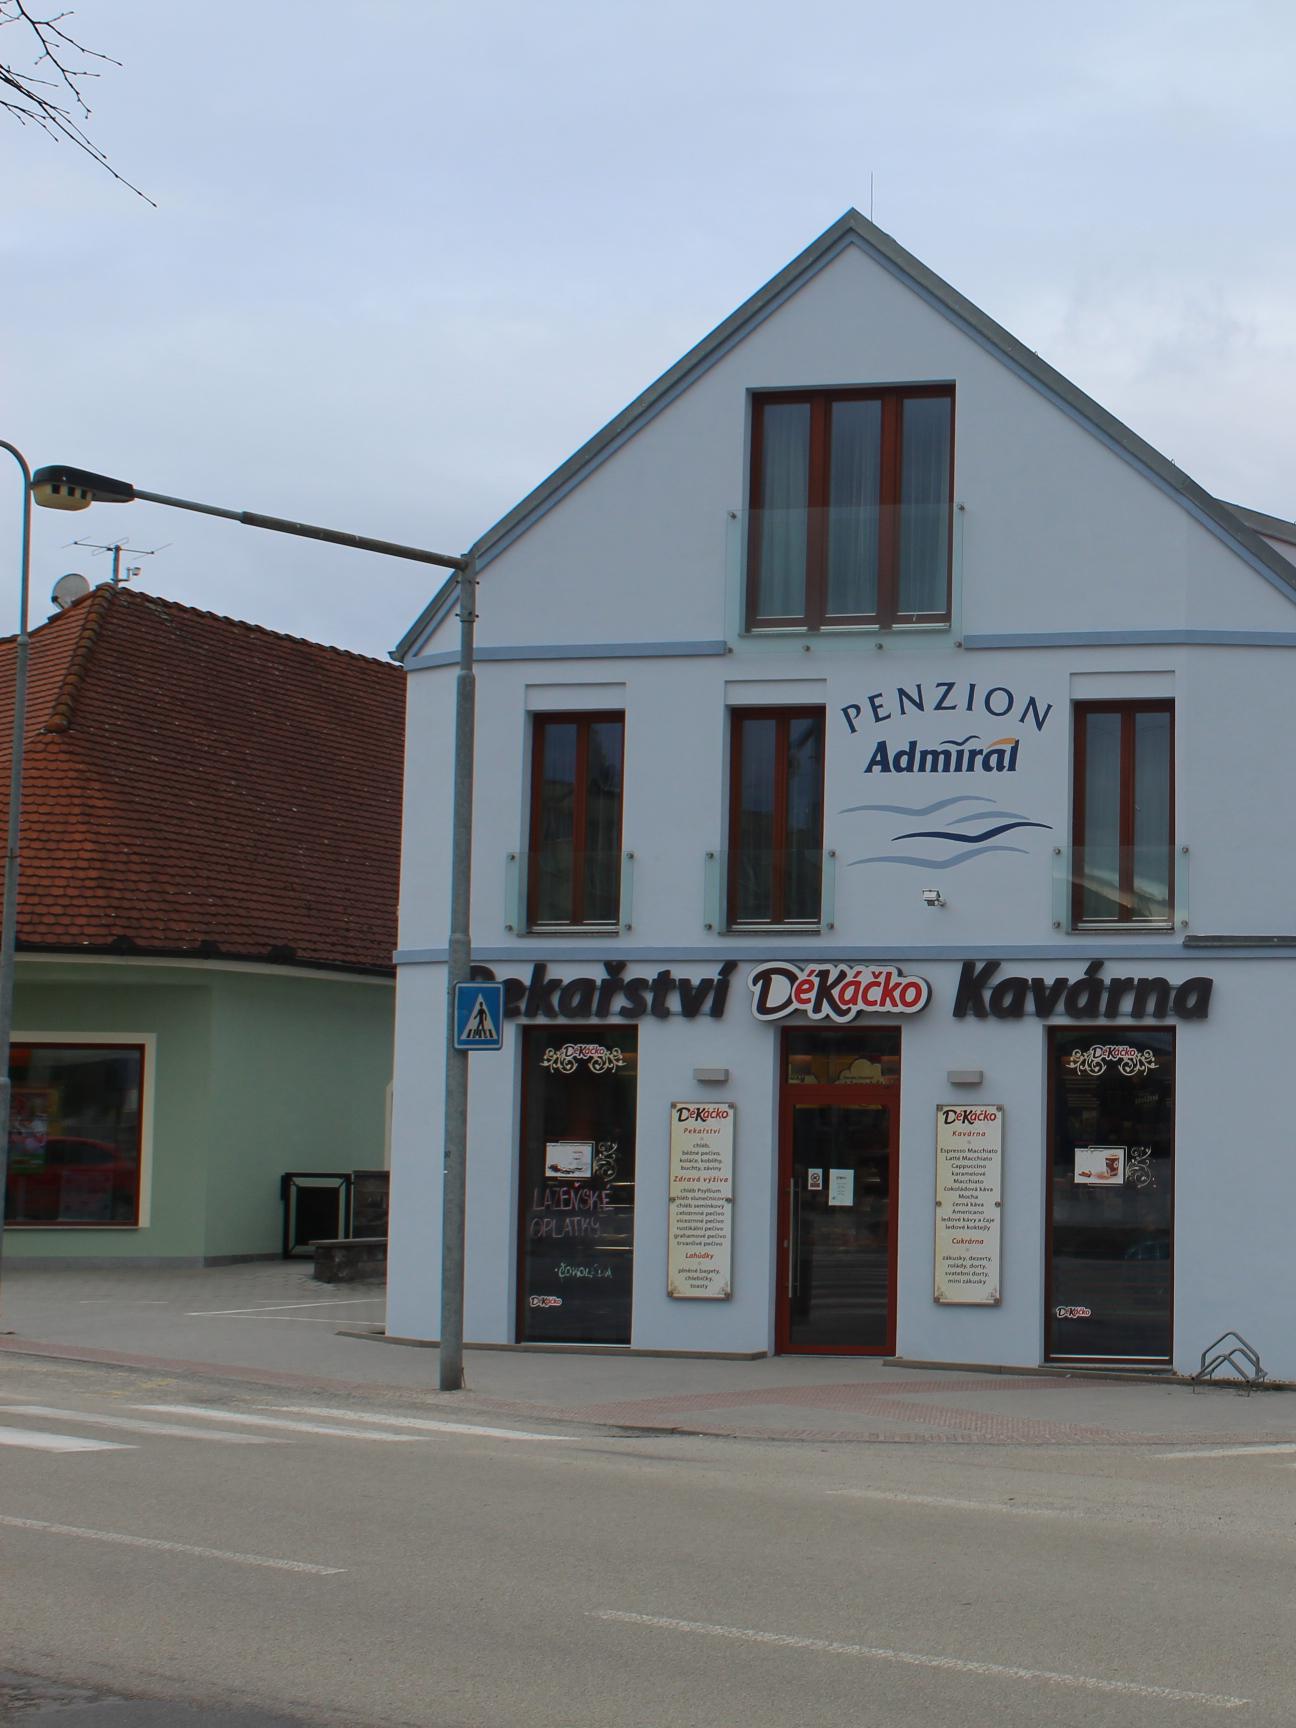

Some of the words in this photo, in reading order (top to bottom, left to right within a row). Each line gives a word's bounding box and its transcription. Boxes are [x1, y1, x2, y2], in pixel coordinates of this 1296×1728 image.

[841, 682, 1053, 734] PENZION
[864, 737, 1020, 773] Admiral
[470, 960, 738, 1018] ekařství
[752, 967, 923, 1018] DéKáčko
[953, 960, 1214, 1019] Kavárna
[676, 1107, 729, 1122] DéKáčko
[942, 1109, 997, 1125] DéKáčko
[673, 1175, 700, 1183] Zdravá
[703, 1175, 729, 1184] výživa
